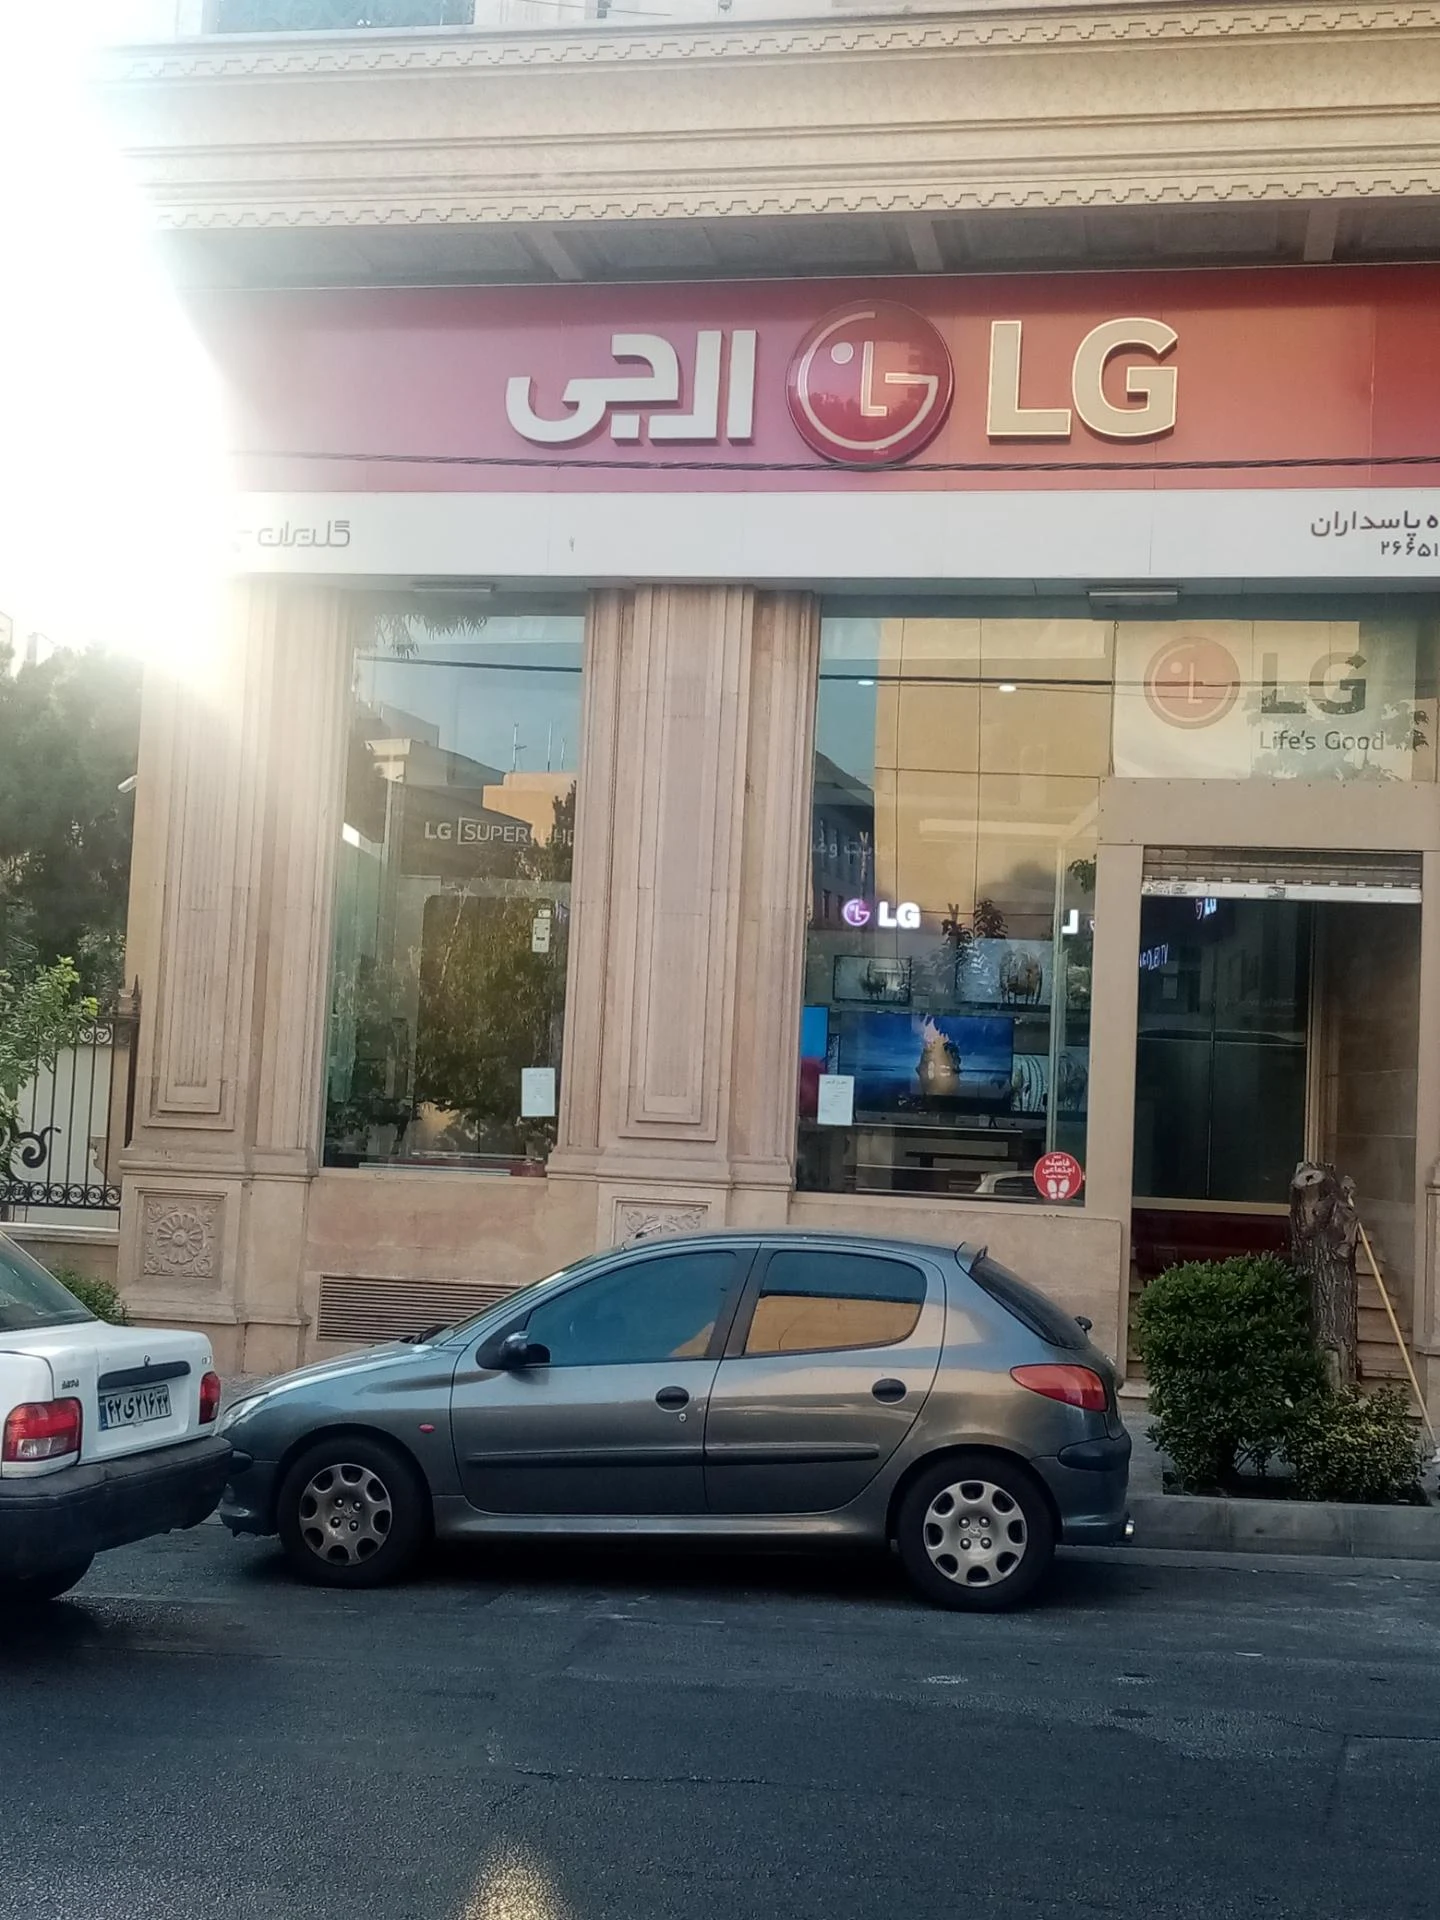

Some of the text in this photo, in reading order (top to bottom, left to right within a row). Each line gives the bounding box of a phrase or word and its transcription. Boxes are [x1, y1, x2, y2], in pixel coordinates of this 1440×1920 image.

[986, 317, 1179, 438] LG
[1311, 510, 1421, 541] پاسداران
[1261, 651, 1368, 715] LG
[1260, 730, 1385, 751] Life's Good
[424, 821, 452, 840] LG
[464, 823, 529, 844] SUPER
[878, 900, 921, 929] LG
